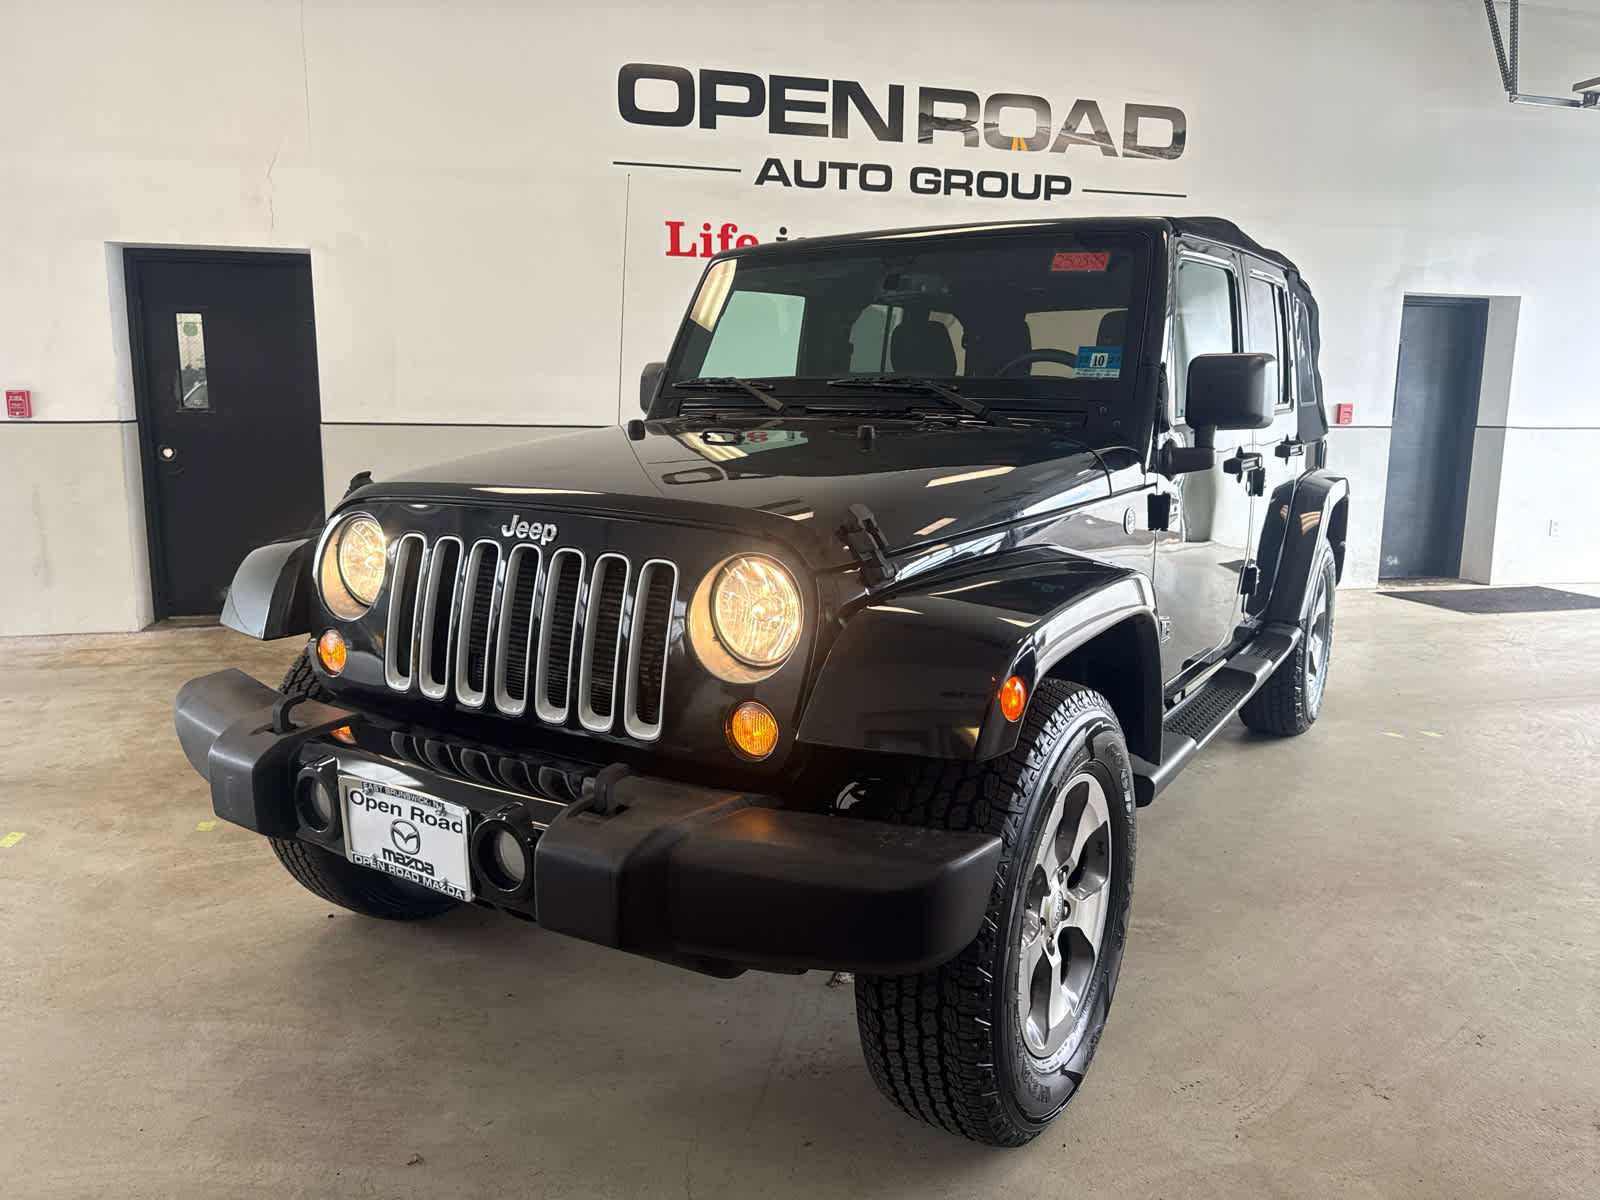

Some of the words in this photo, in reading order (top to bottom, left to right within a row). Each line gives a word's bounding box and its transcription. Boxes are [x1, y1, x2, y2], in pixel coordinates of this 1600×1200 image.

[617, 62, 905, 143] OPEN
[917, 86, 1188, 161] ROAD
[754, 157, 893, 192] AUTO
[909, 167, 1072, 200] GROUP
[1092, 354, 1105, 367] 10
[501, 514, 557, 546] Jeep
[349, 790, 401, 817] Open
[411, 806, 463, 834] Road
[353, 855, 385, 872] OPEN
[389, 866, 419, 883] ROAD
[423, 877, 465, 900] MAZDA
[382, 848, 435, 877] mazda
